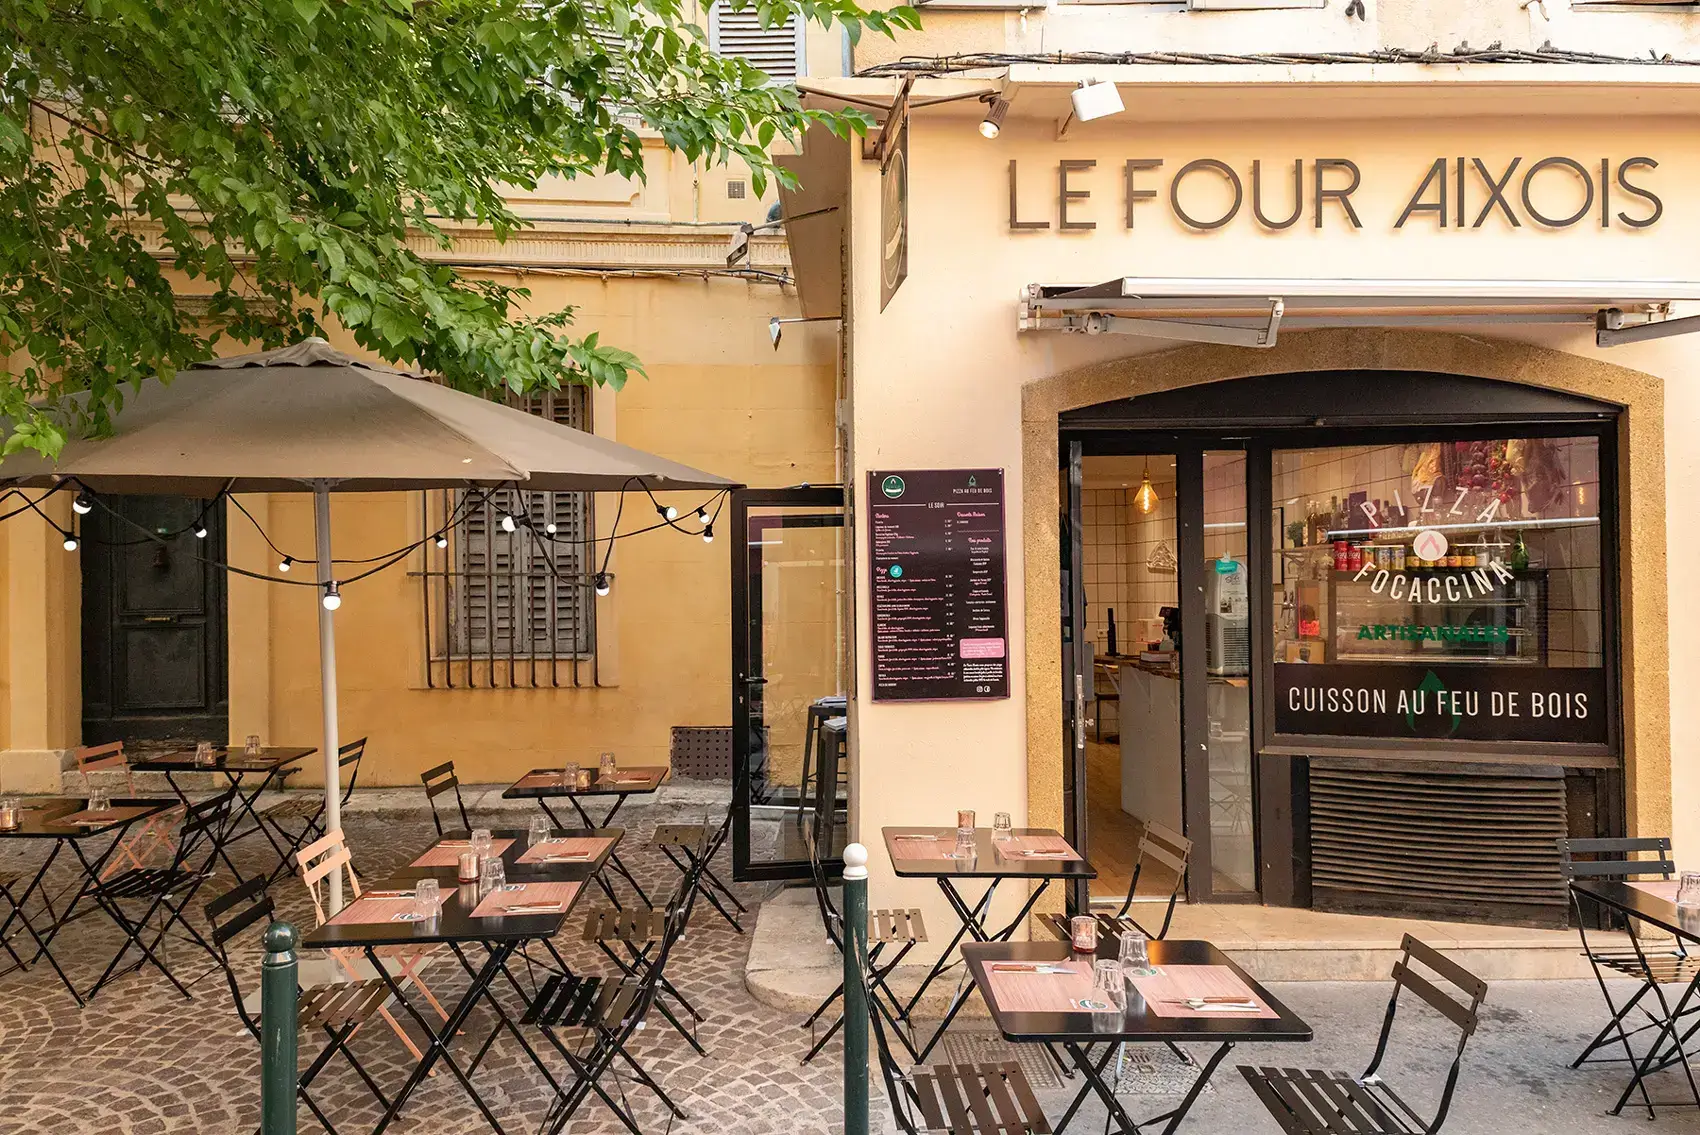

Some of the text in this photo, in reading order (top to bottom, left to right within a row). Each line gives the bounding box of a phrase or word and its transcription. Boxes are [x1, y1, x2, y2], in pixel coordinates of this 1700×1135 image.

[1009, 155, 1663, 230] LE FOUR AIXOIS
[1360, 485, 1501, 528] PIZZA
[1353, 560, 1514, 604] FOCACCINA
[1357, 624, 1509, 643] ARTISANALES
[1288, 686, 1588, 719] CUISSON AU FEU DE BOIS
